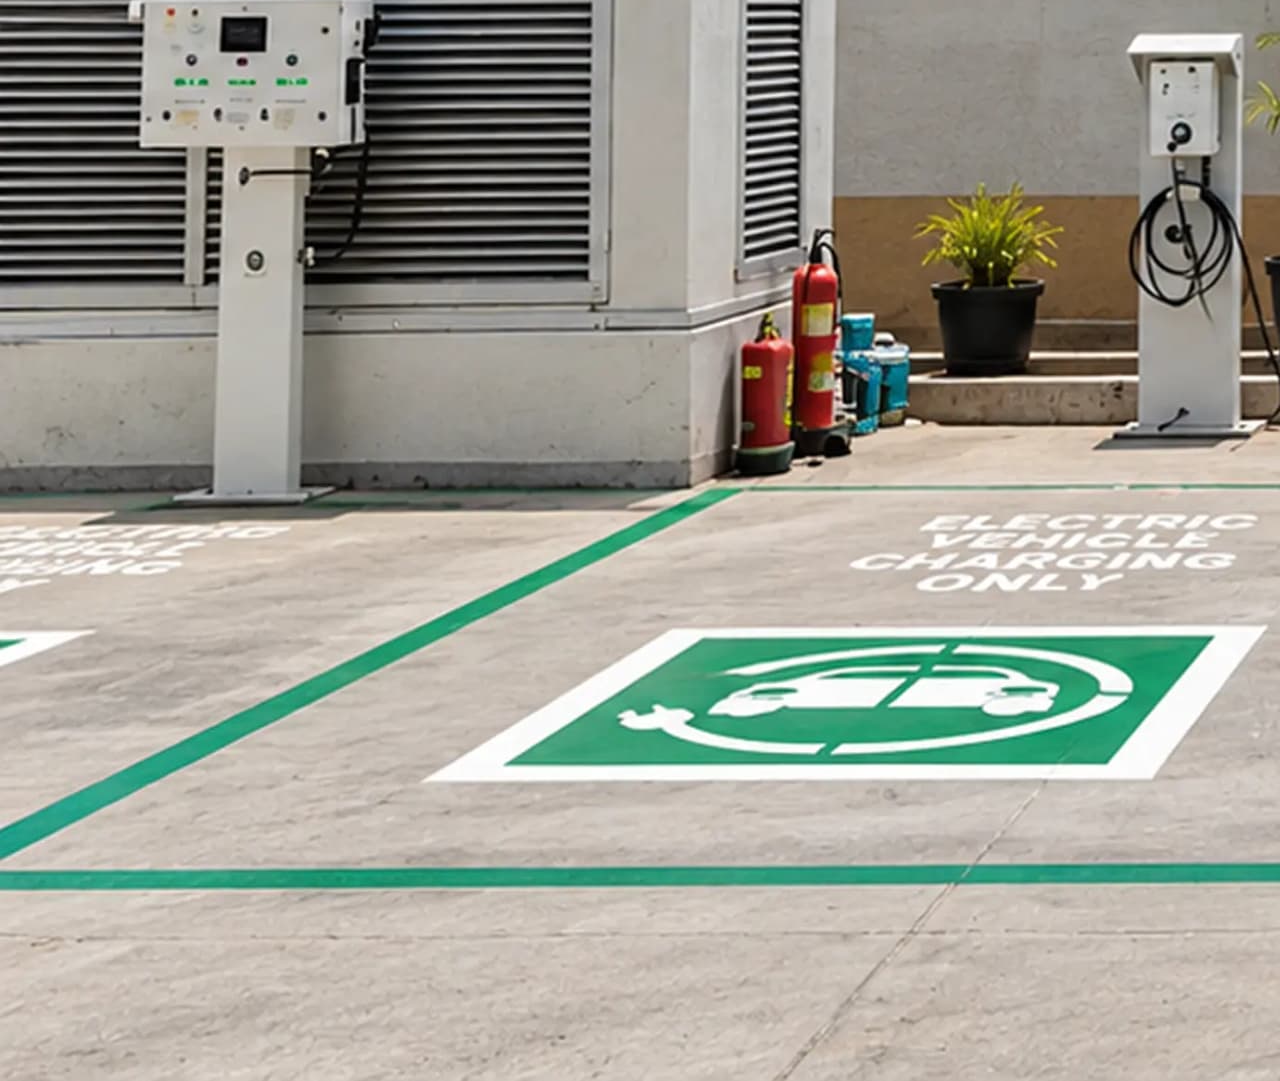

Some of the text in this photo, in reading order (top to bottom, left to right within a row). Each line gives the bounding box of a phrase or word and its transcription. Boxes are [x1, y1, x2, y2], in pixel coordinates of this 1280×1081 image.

[920, 513, 1258, 531] ELECTRIC
[931, 531, 1219, 549] VEHICLE
[849, 551, 1237, 570] CHARGING
[916, 572, 1124, 592] ONLY
